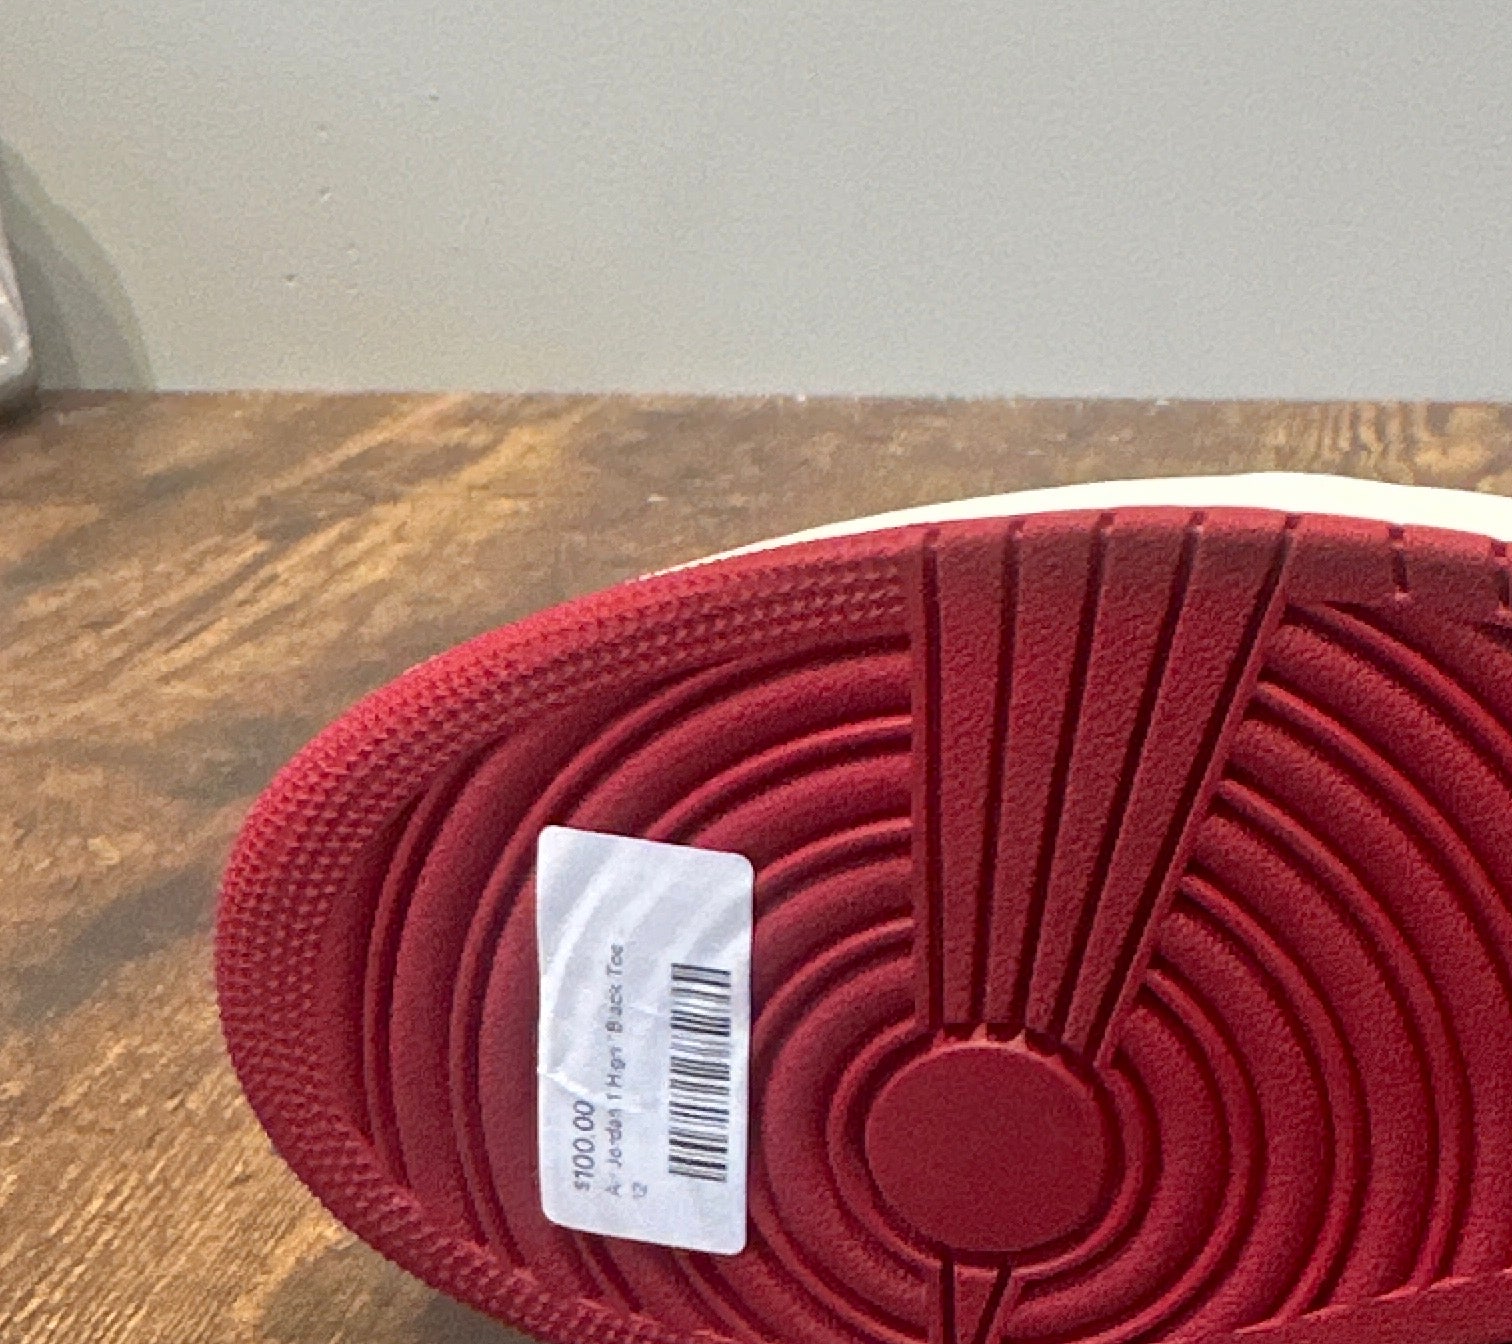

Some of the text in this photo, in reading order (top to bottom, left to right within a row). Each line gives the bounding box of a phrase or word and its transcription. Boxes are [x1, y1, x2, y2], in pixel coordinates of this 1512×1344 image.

[604, 1046, 627, 1089] Hgh
[572, 1099, 596, 1192] $100.00
[603, 1108, 624, 1168] Jordan
[604, 1172, 622, 1198] Ar
